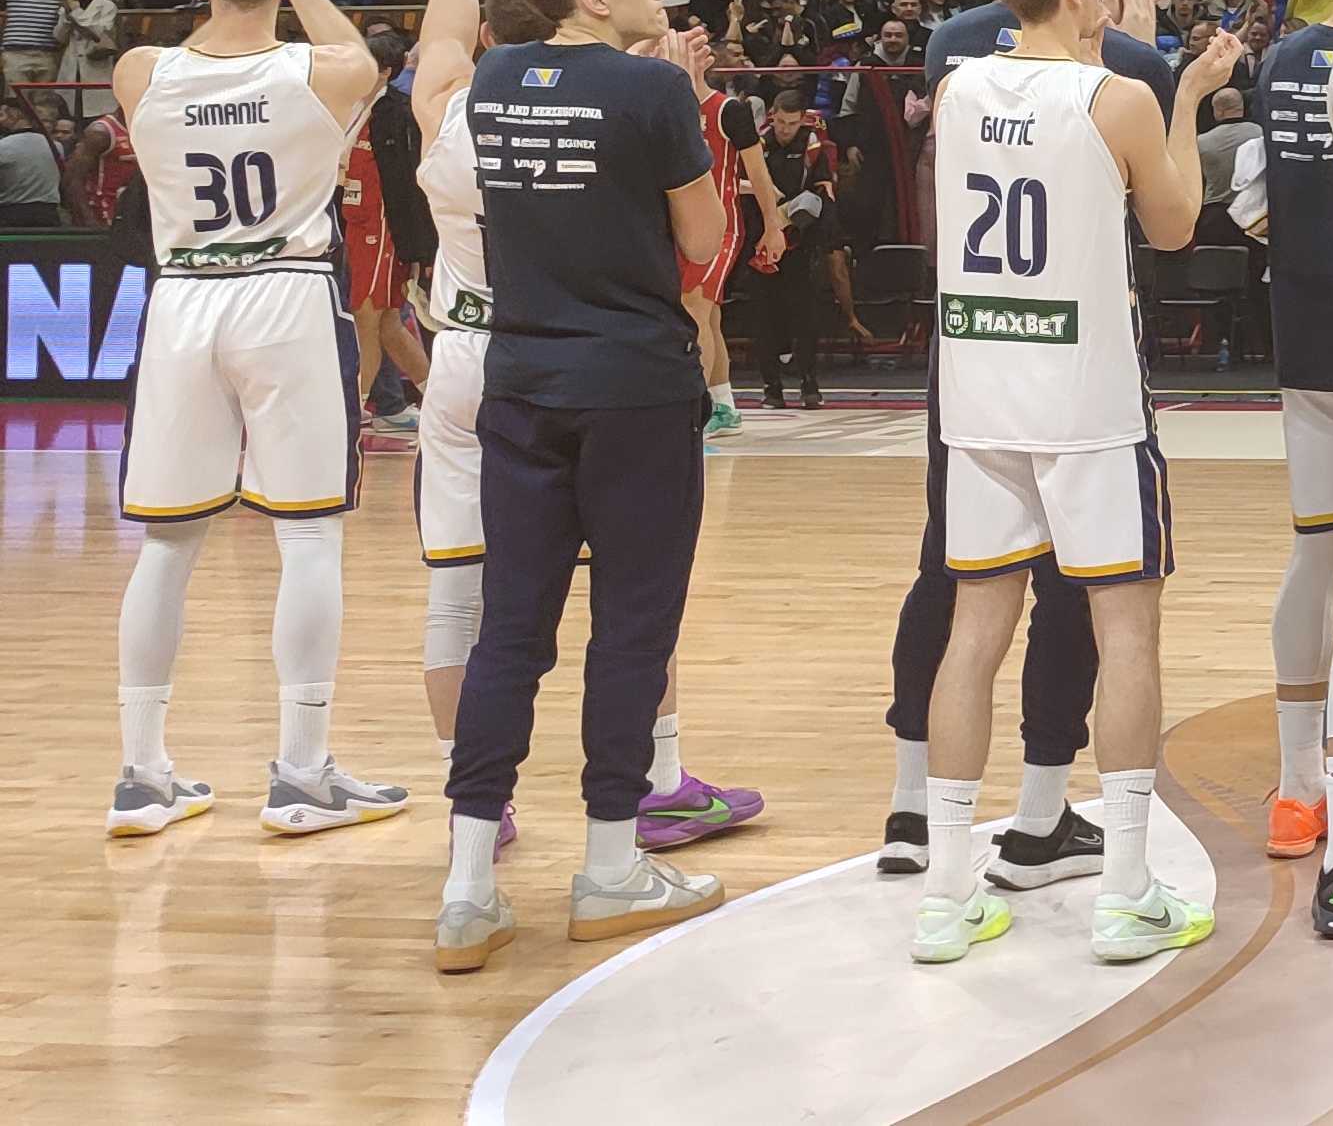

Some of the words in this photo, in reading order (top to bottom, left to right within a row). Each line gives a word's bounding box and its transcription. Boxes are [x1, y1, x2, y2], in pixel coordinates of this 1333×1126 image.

[184, 94, 270, 127] SIMANIĆ
[506, 105, 530, 117] AND
[980, 112, 1036, 146] GUTIĆ
[184, 150, 278, 233] 30
[962, 172, 1048, 277] 20
[972, 307, 1069, 338] MAXBET
